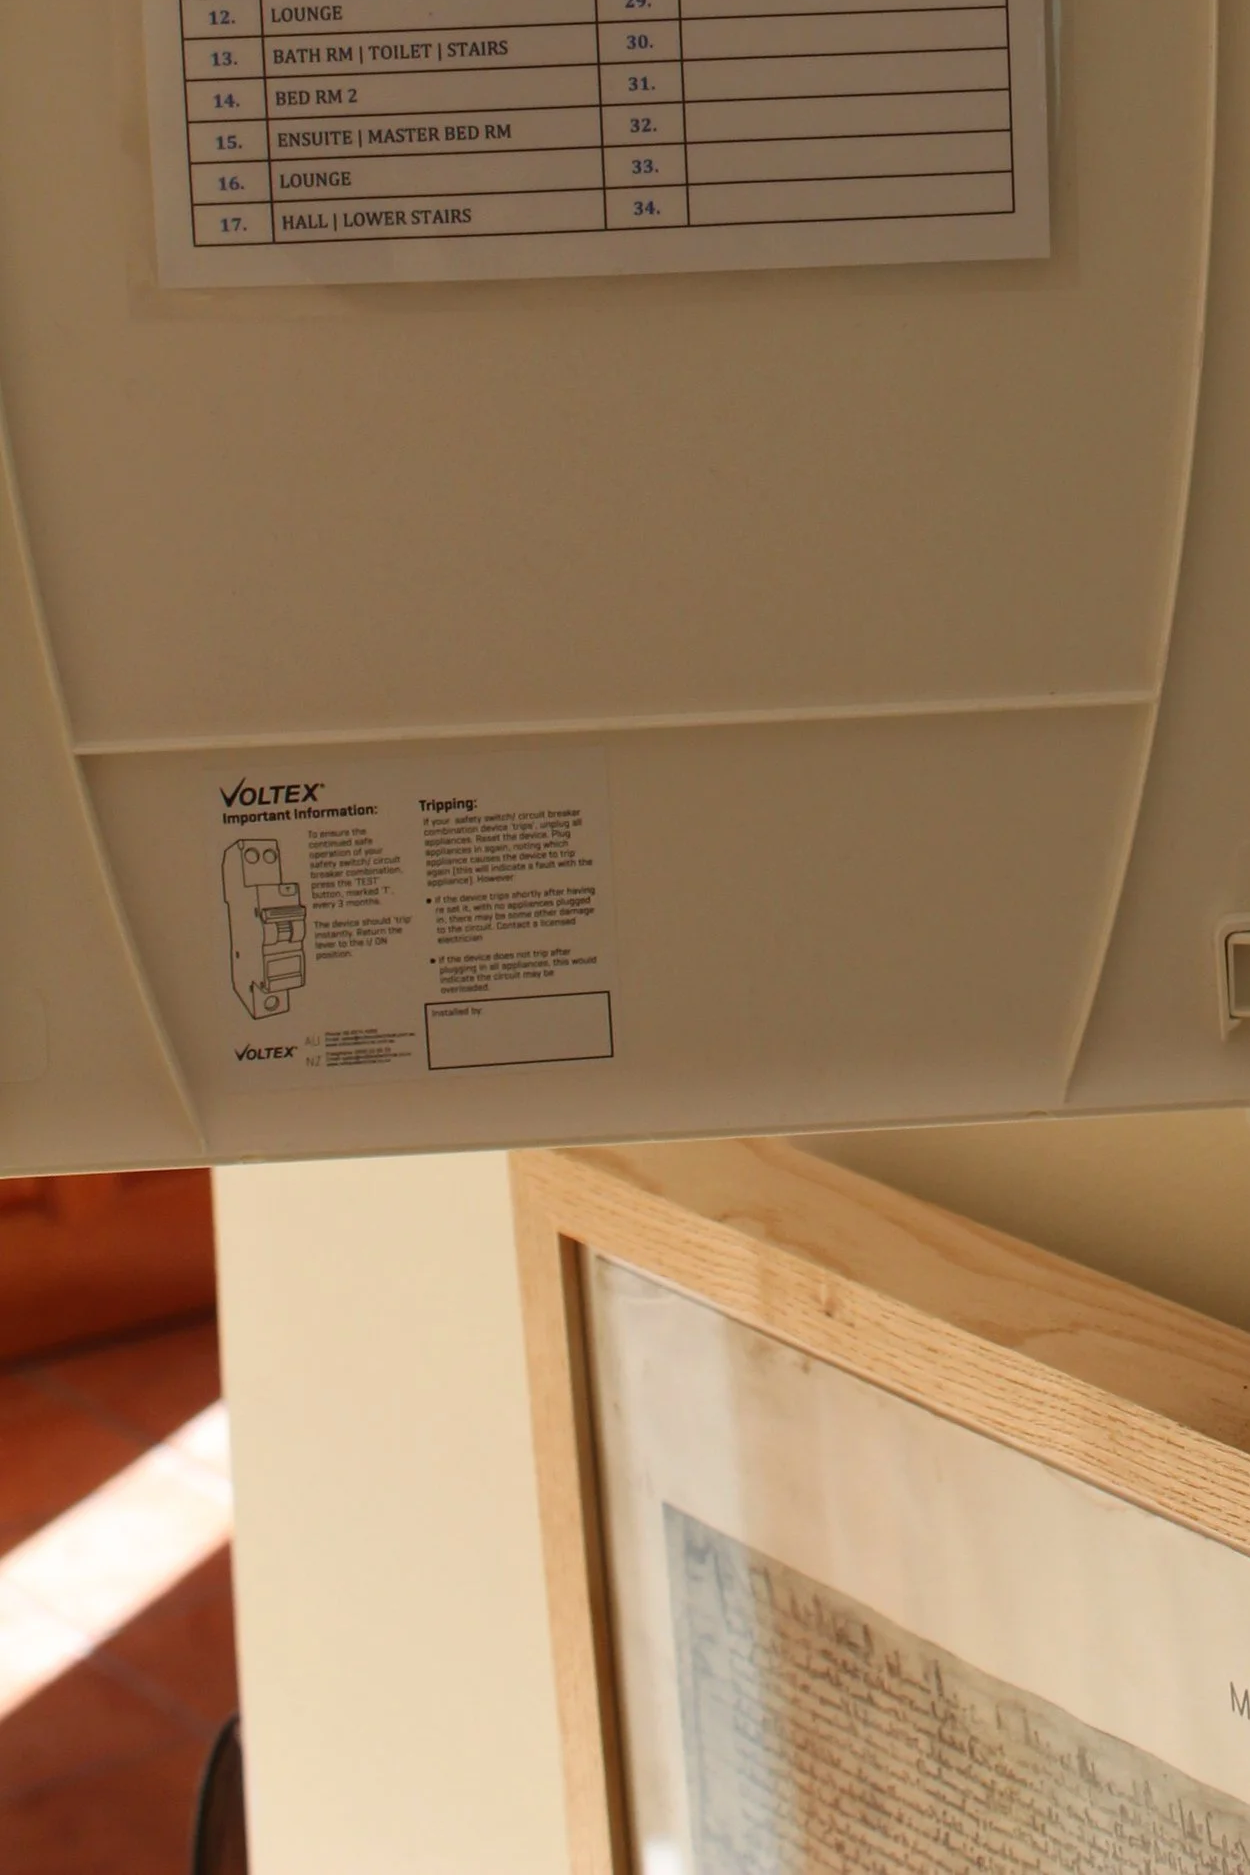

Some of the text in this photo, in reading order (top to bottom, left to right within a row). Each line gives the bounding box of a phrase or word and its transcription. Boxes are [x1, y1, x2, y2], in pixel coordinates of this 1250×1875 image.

[271, 5, 343, 23] LOUNGE
[273, 40, 508, 64] BATH RM TOILET STAIRS
[275, 88, 358, 106] BED RM 2
[277, 124, 512, 148] ENSUITE MASTER BED RM
[280, 171, 352, 189] LOUNGE
[282, 208, 472, 231] HALL LOWER STAIRS
[223, 804, 378, 825] Important Information:
[418, 798, 478, 813] Tripping:
